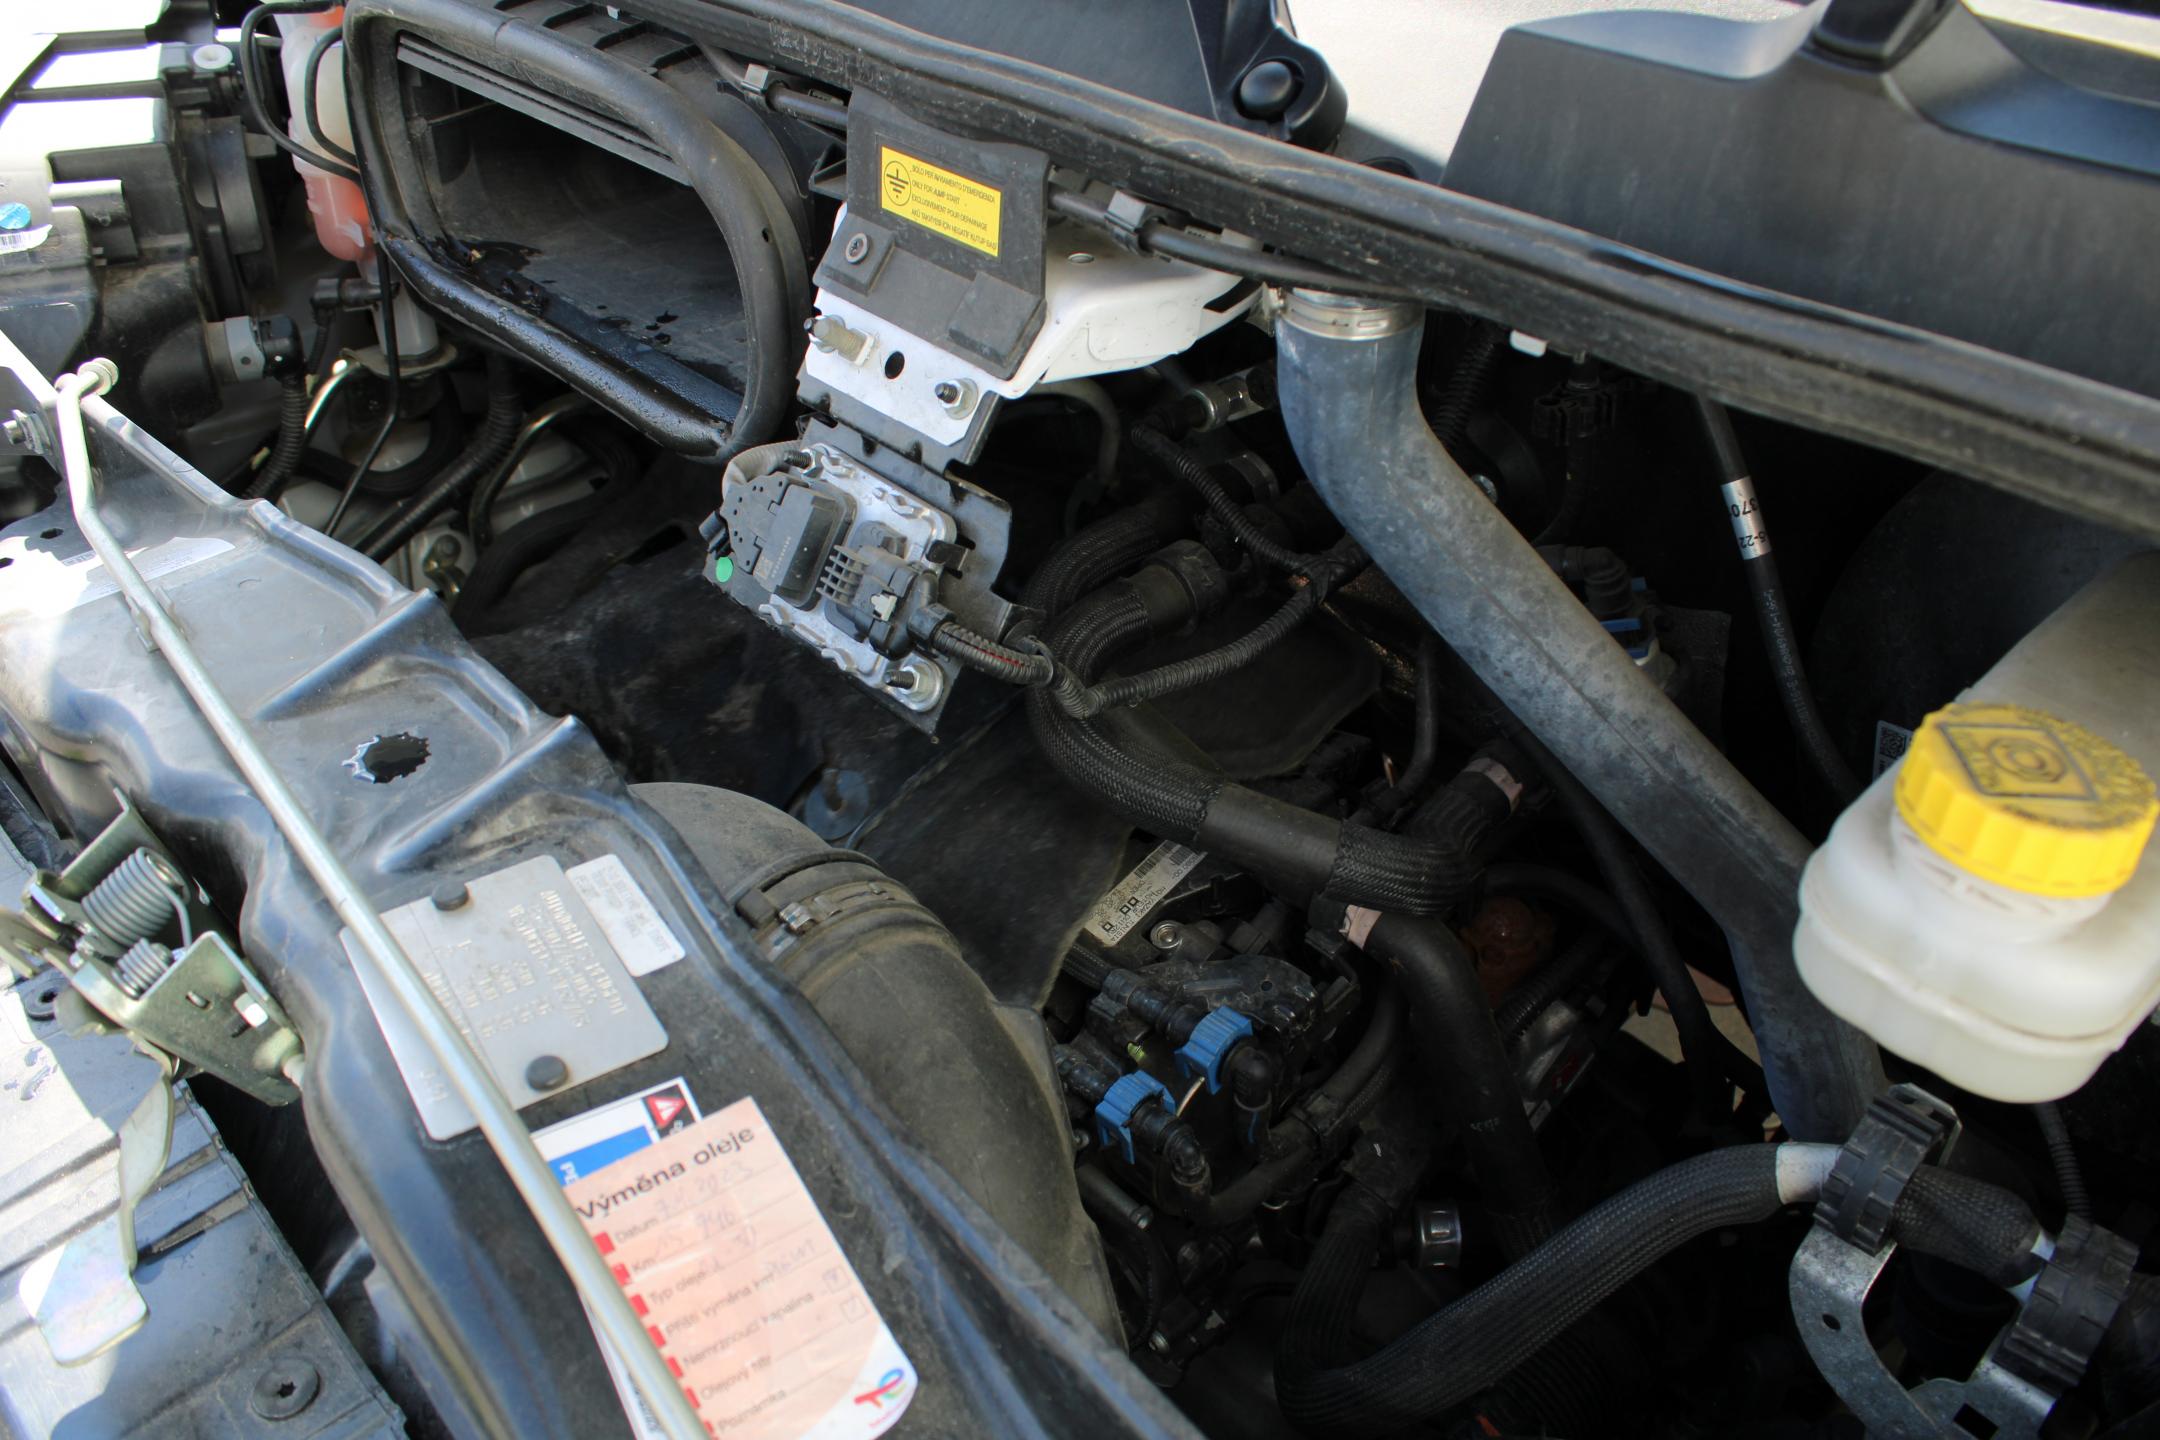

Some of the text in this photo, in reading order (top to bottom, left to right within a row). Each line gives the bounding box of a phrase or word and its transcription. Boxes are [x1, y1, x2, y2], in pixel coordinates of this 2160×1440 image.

[576, 1128, 755, 1217] Výměna oleje
[615, 1217, 659, 1242] Datum
[650, 1287, 673, 1305] Typ
